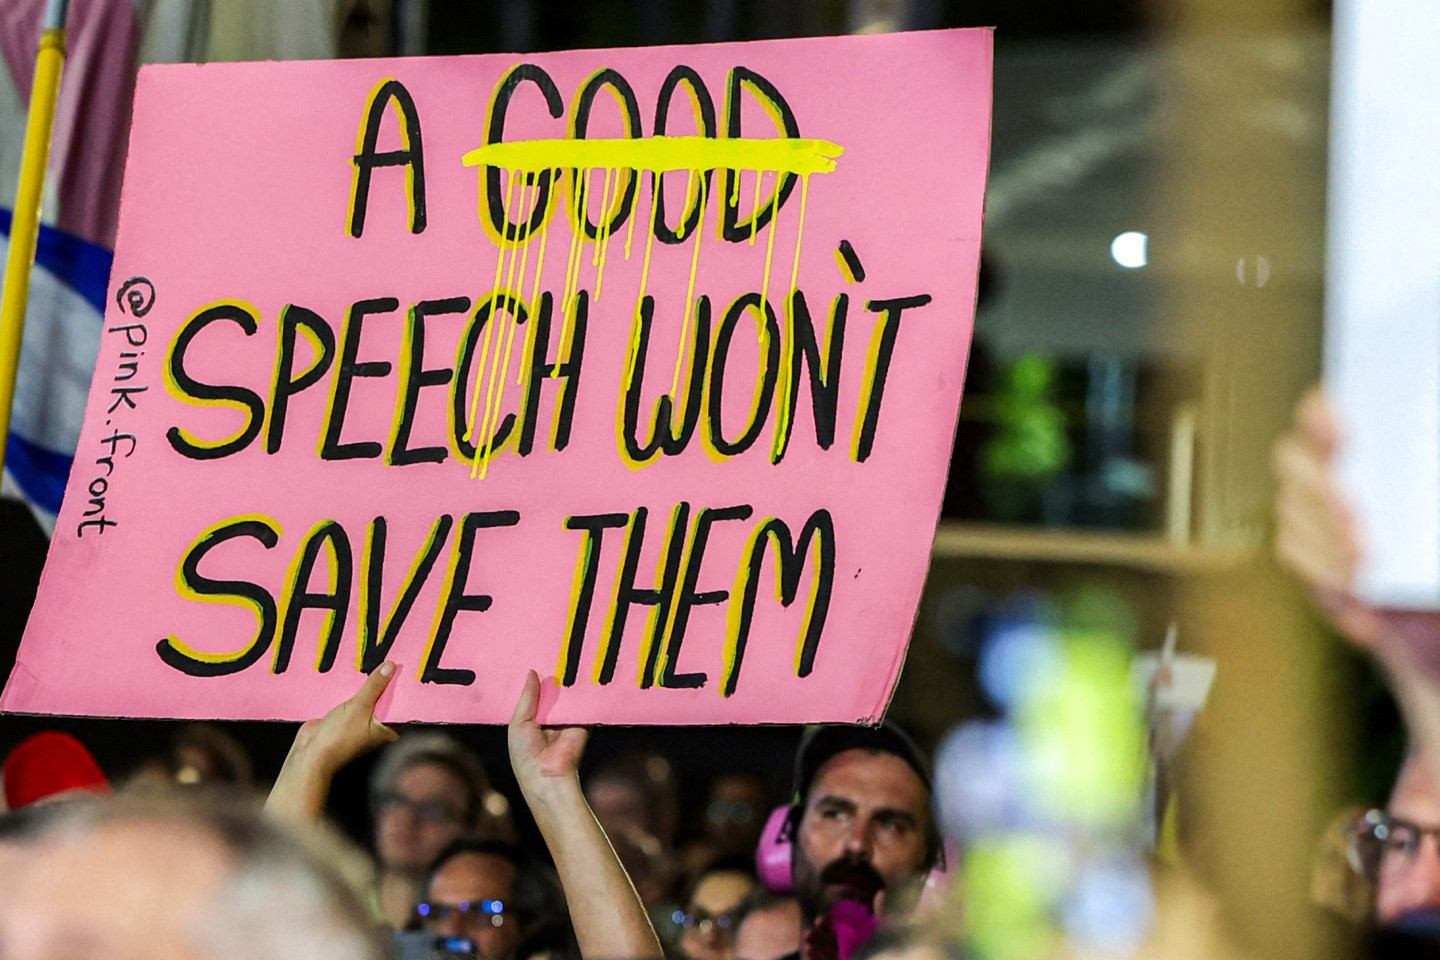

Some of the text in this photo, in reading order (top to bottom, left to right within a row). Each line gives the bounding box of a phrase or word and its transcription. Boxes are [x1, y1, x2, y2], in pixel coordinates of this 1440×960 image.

[346, 63, 801, 246] A GOOD
[77, 276, 156, 538] @pink.front
[165, 239, 934, 469] SPEECH WON'T
[155, 499, 835, 696] SAVE THEM
